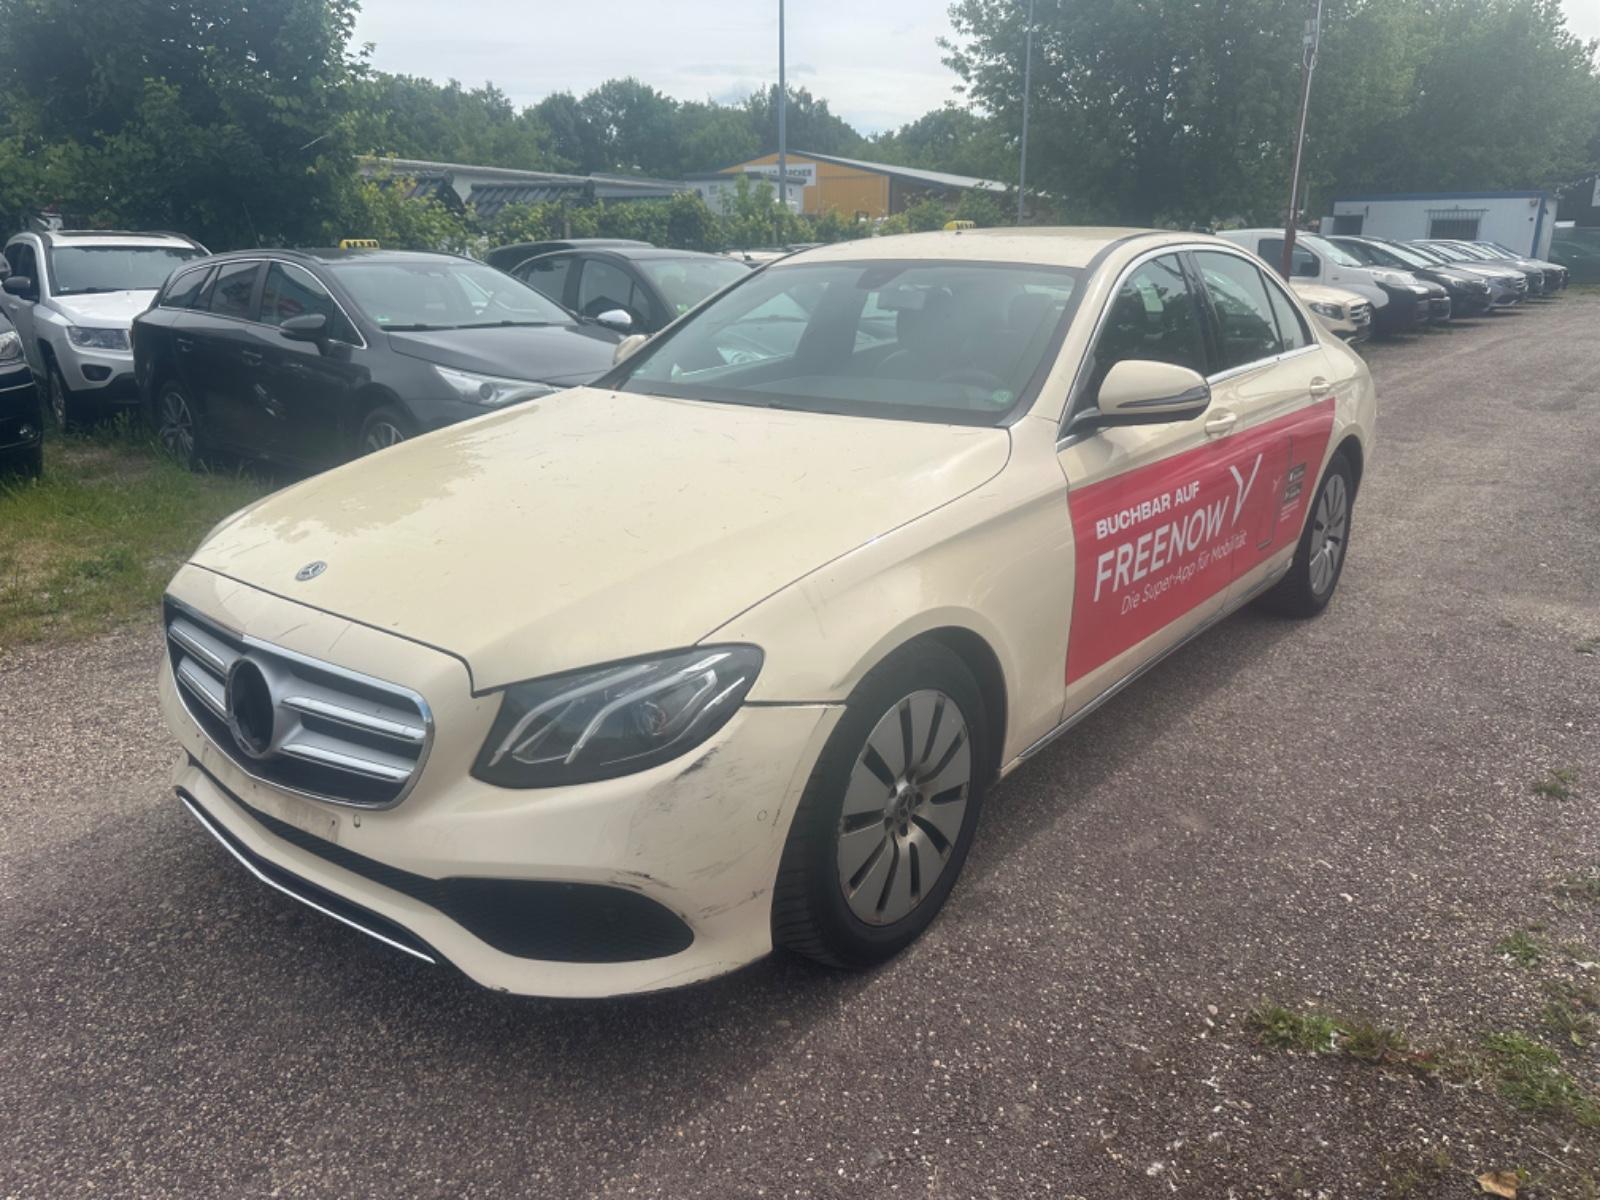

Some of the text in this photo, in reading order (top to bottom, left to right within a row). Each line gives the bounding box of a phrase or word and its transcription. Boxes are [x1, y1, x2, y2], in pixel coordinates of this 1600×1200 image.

[1096, 480, 1200, 540] BUCHBAR AUF
[1093, 496, 1230, 603] FREENOW
[1120, 590, 1140, 615] Die
